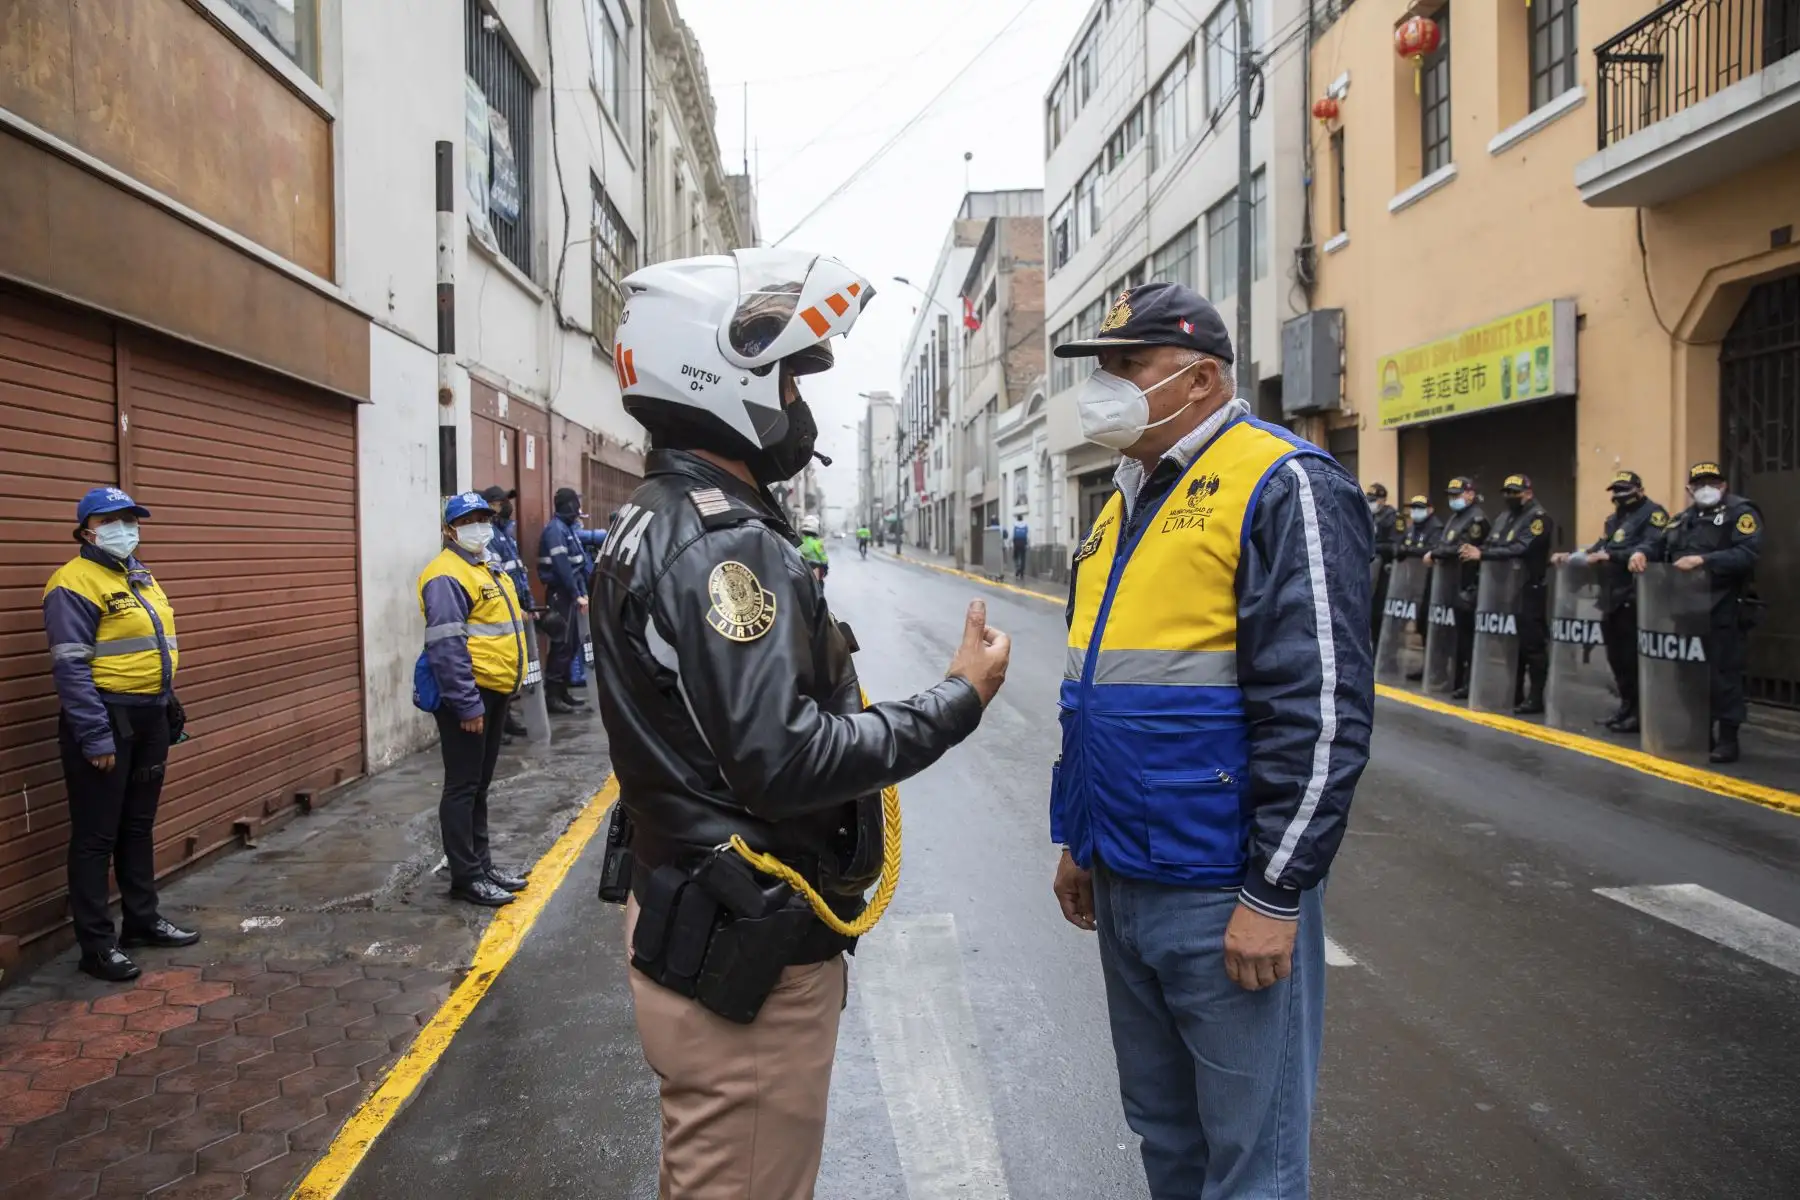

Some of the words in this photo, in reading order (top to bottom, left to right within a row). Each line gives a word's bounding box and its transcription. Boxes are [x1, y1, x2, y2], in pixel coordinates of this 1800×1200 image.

[681, 364, 721, 385] DIVTSV
[1421, 363, 1487, 402] 幸运超市
[690, 380, 704, 391] O+
[1161, 516, 1205, 534] LIMA
